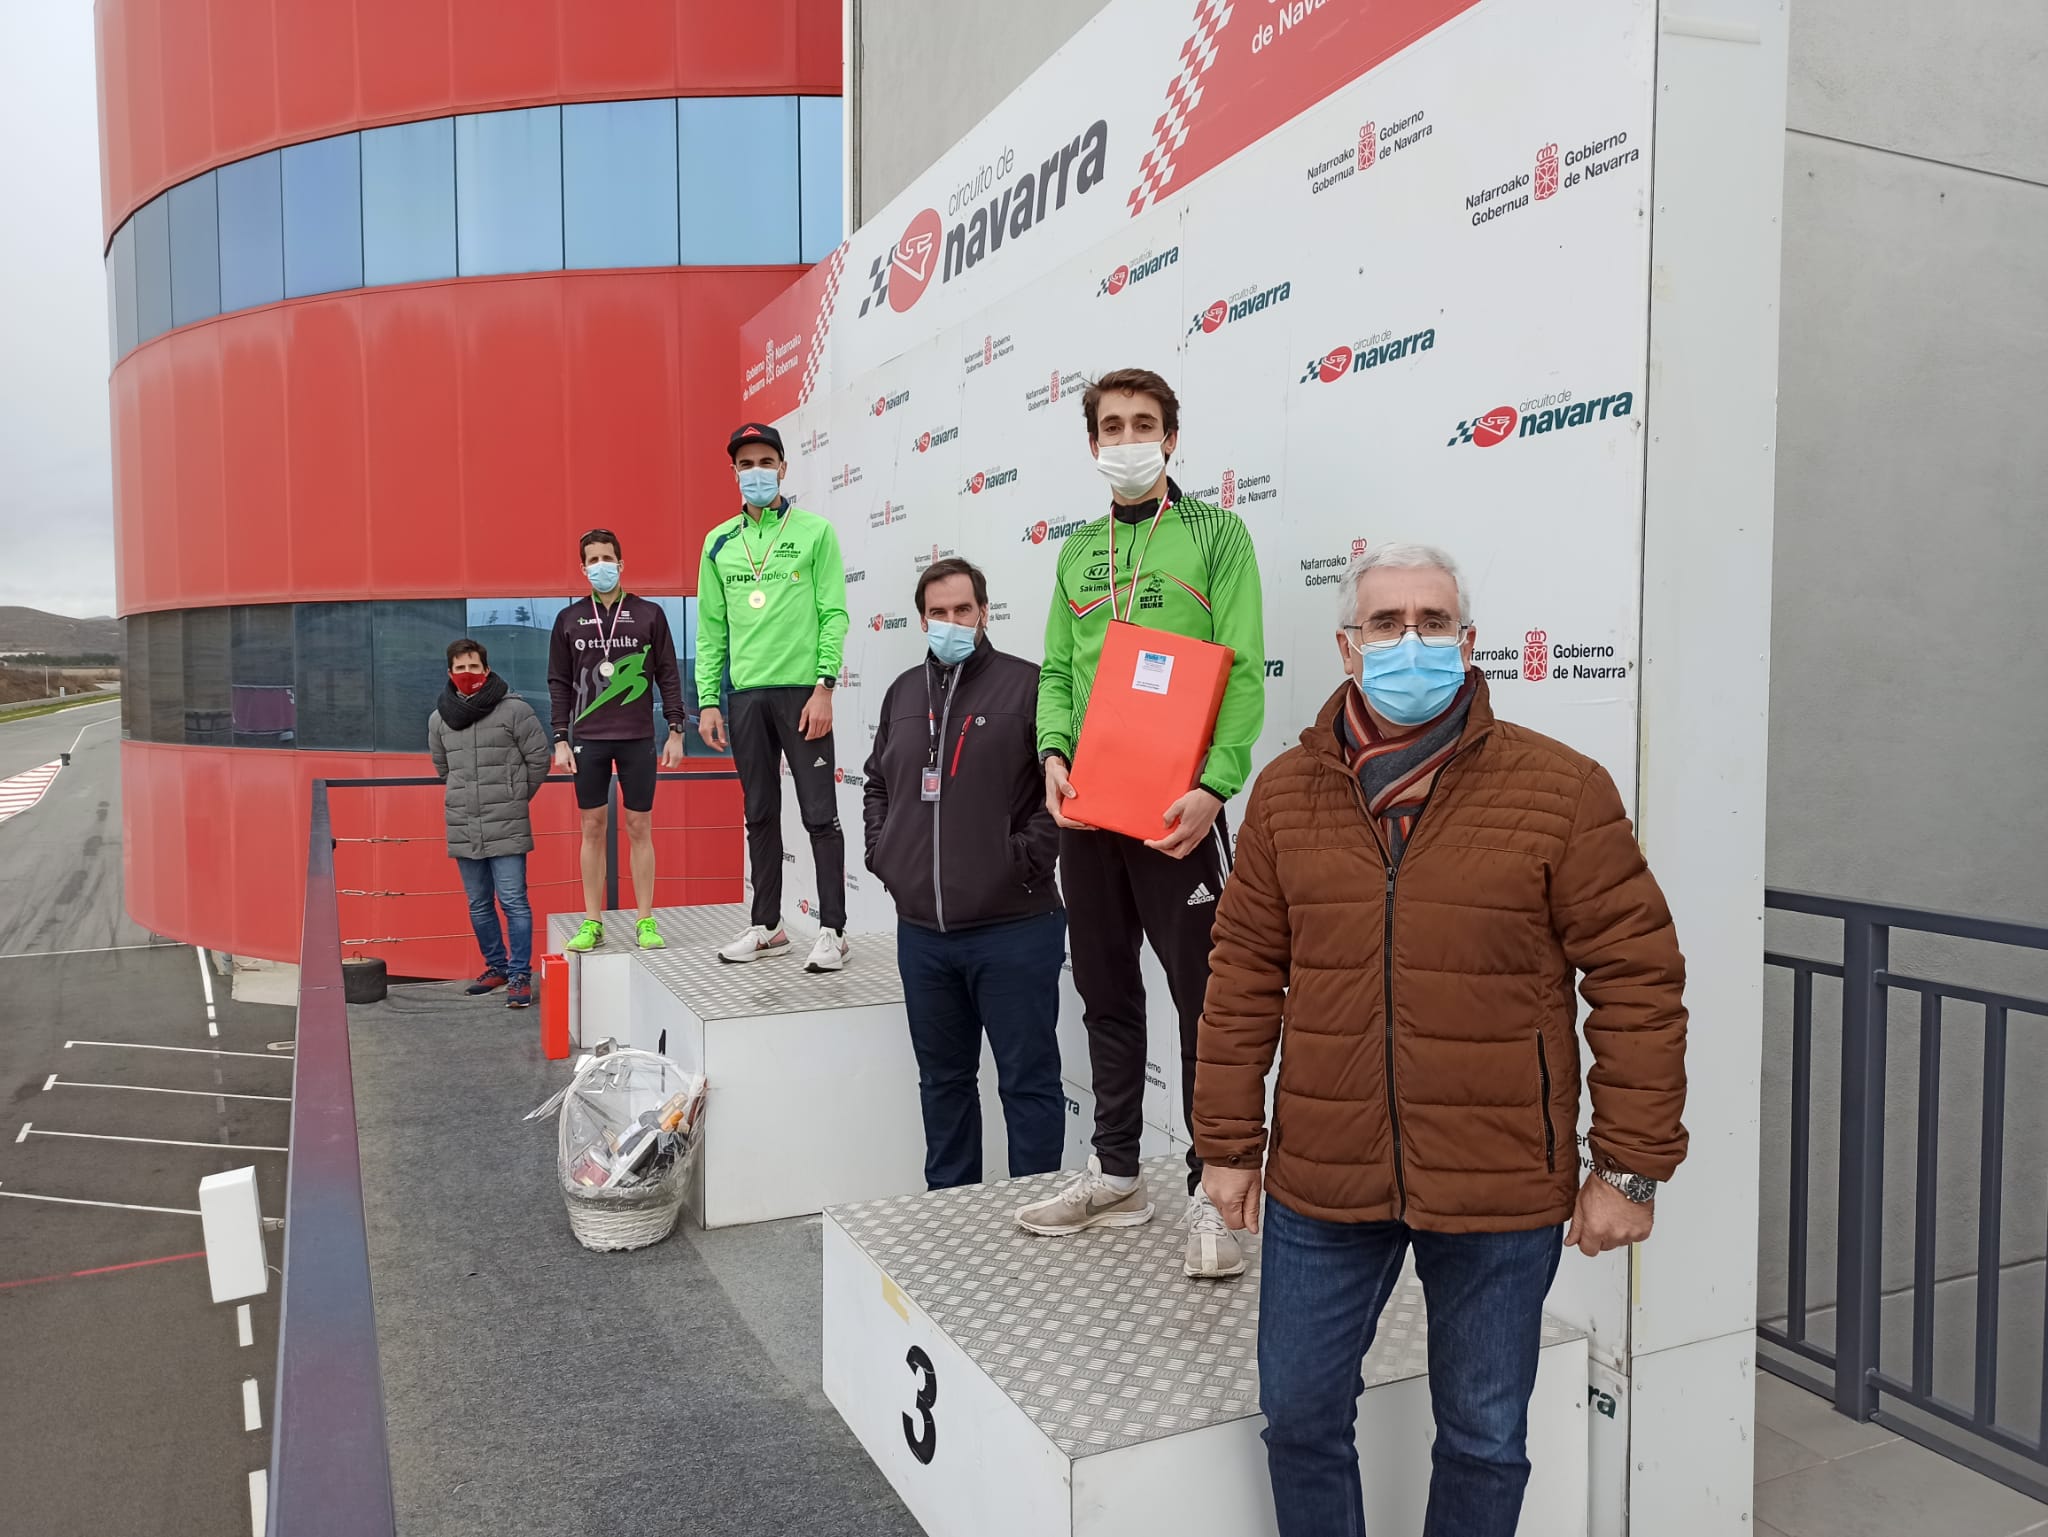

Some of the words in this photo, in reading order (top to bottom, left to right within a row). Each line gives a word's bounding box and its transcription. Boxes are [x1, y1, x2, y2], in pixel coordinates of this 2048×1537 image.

[1251, 24, 1273, 54] de
[1379, 109, 1424, 141] Gobierno
[1379, 148, 1391, 161] de
[1394, 123, 1433, 153] Navarra
[1564, 131, 1628, 167] Gobierno
[1307, 146, 1355, 181] Nafarroako
[1563, 172, 1580, 189] de
[1585, 148, 1640, 180] Navarra
[948, 164, 993, 217] circuito
[996, 145, 1015, 180] de
[1312, 164, 1355, 195] Gobernua
[1465, 172, 1530, 210] Nafarroako
[943, 119, 1108, 284] navarra
[1472, 193, 1529, 227] Gobernua
[1128, 246, 1179, 286] navarra
[1228, 280, 1291, 323] navarra
[1352, 328, 1436, 373] navarra
[1353, 333, 1380, 350] circuito
[885, 390, 910, 412] navarra
[1518, 391, 1634, 438] navarra
[1519, 392, 1556, 413] circuito
[1556, 389, 1572, 403] de
[930, 426, 959, 448] navarra
[984, 467, 1018, 490] navarra
[1237, 473, 1271, 490] Gobierno
[1236, 495, 1246, 505] de
[1248, 487, 1277, 503] Navarra
[780, 542, 795, 550] PA
[1300, 554, 1347, 571] Nafarroako
[1305, 573, 1343, 587] Gobernu
[1553, 643, 1614, 659] Gobierno
[1552, 665, 1569, 679] de
[1573, 664, 1626, 679] Navarra
[1187, 894, 1215, 906] adidas
[902, 1344, 938, 1466] 3
